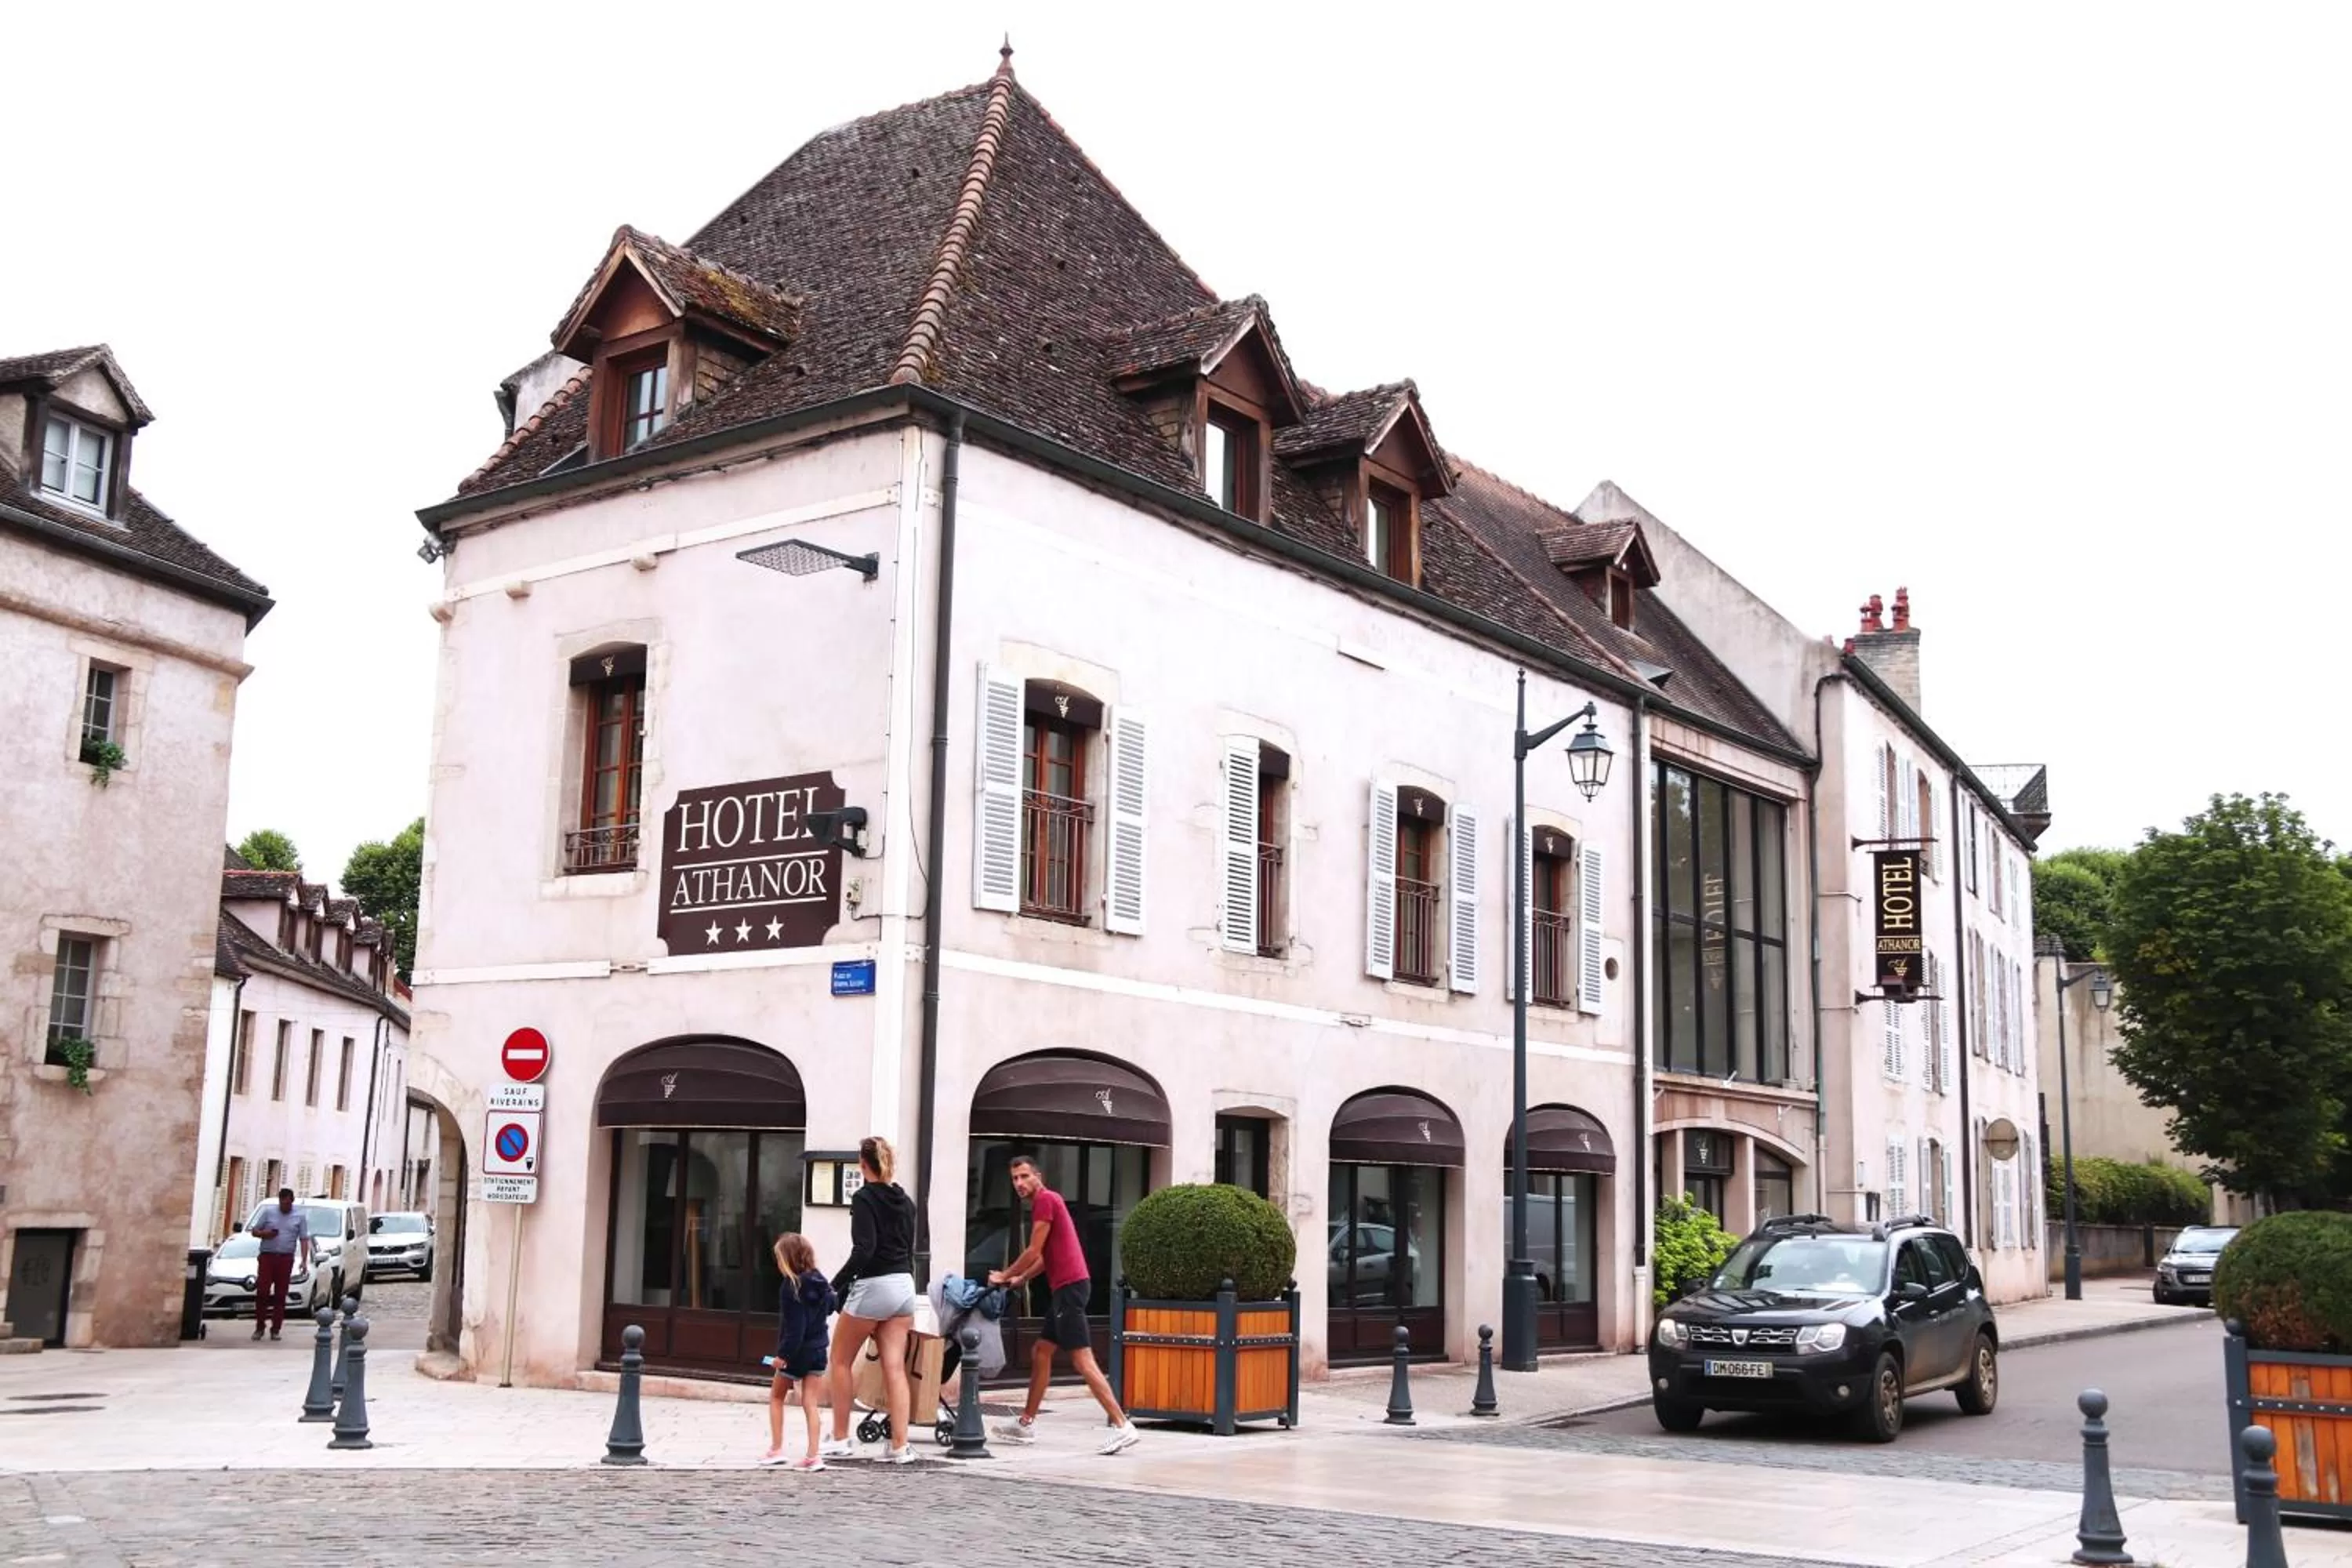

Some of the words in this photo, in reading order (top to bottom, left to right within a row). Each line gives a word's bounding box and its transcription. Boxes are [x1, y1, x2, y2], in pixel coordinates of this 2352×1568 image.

[677, 786, 820, 852] HOTEL
[671, 858, 826, 906] ATHANOR
[1882, 857, 1913, 929] HOTEL
[1878, 939, 1920, 951] ATHANOR
[489, 1098, 539, 1106] RIVERAINS
